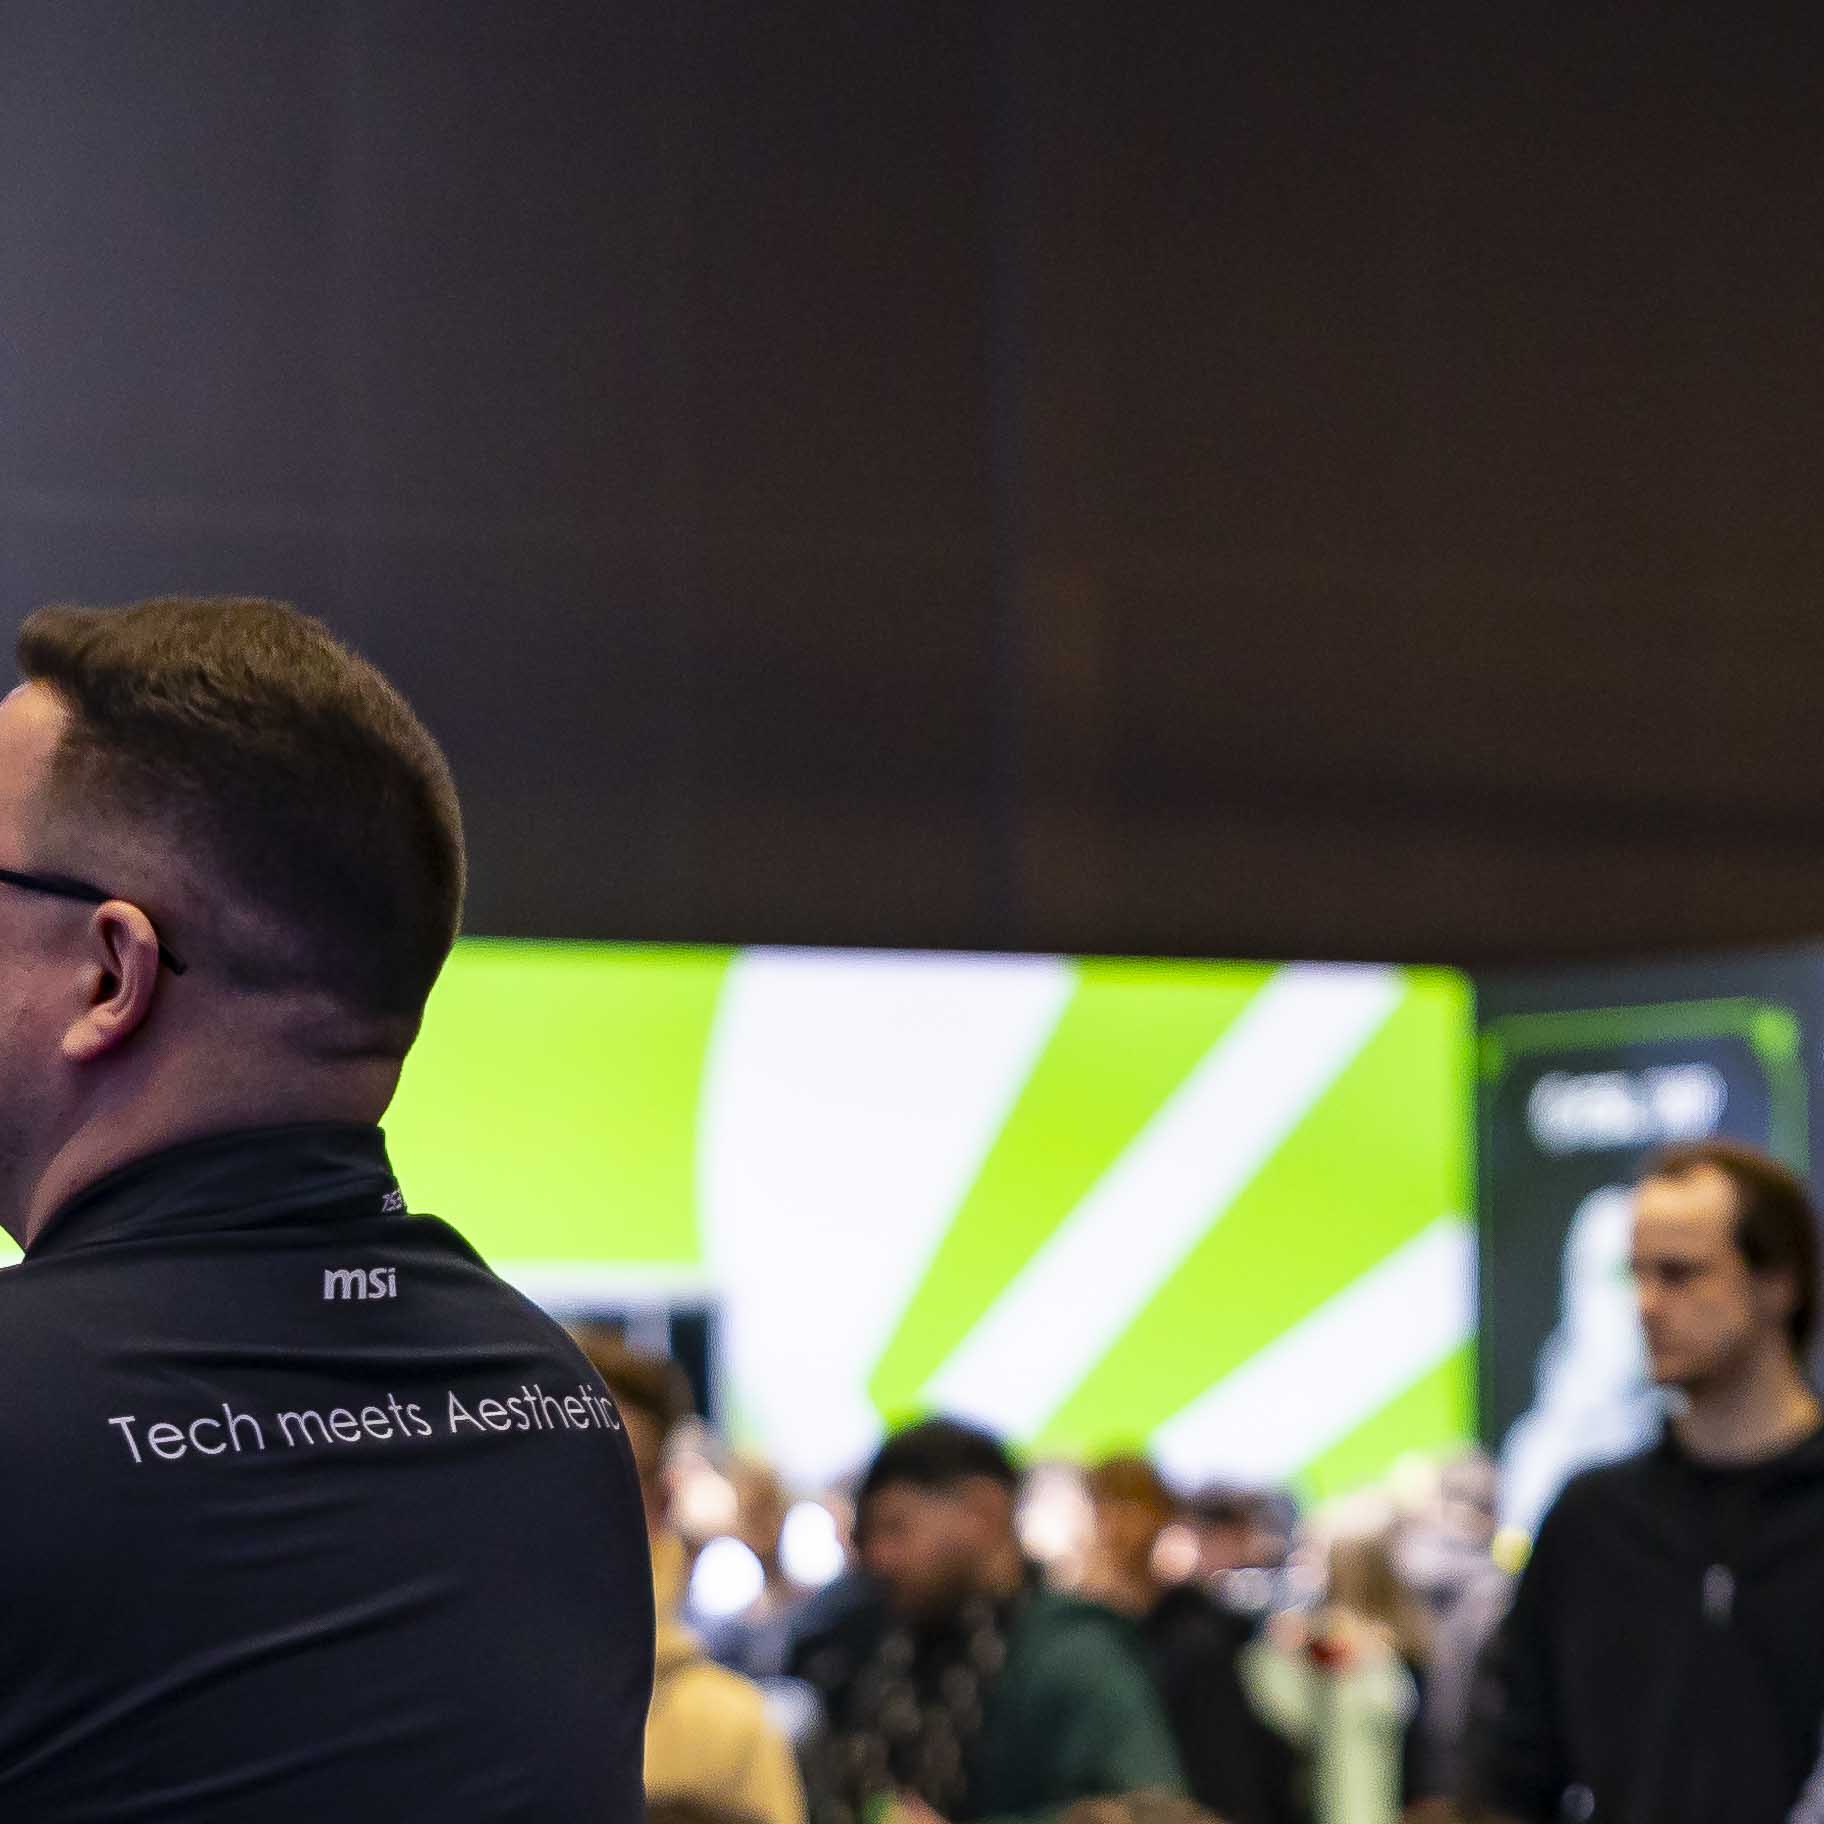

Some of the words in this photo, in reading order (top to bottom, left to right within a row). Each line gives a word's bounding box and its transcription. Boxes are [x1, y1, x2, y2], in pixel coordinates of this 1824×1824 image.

[323, 1267, 397, 1300] msi
[108, 1403, 265, 1463] Tech
[277, 1393, 432, 1448] meets
